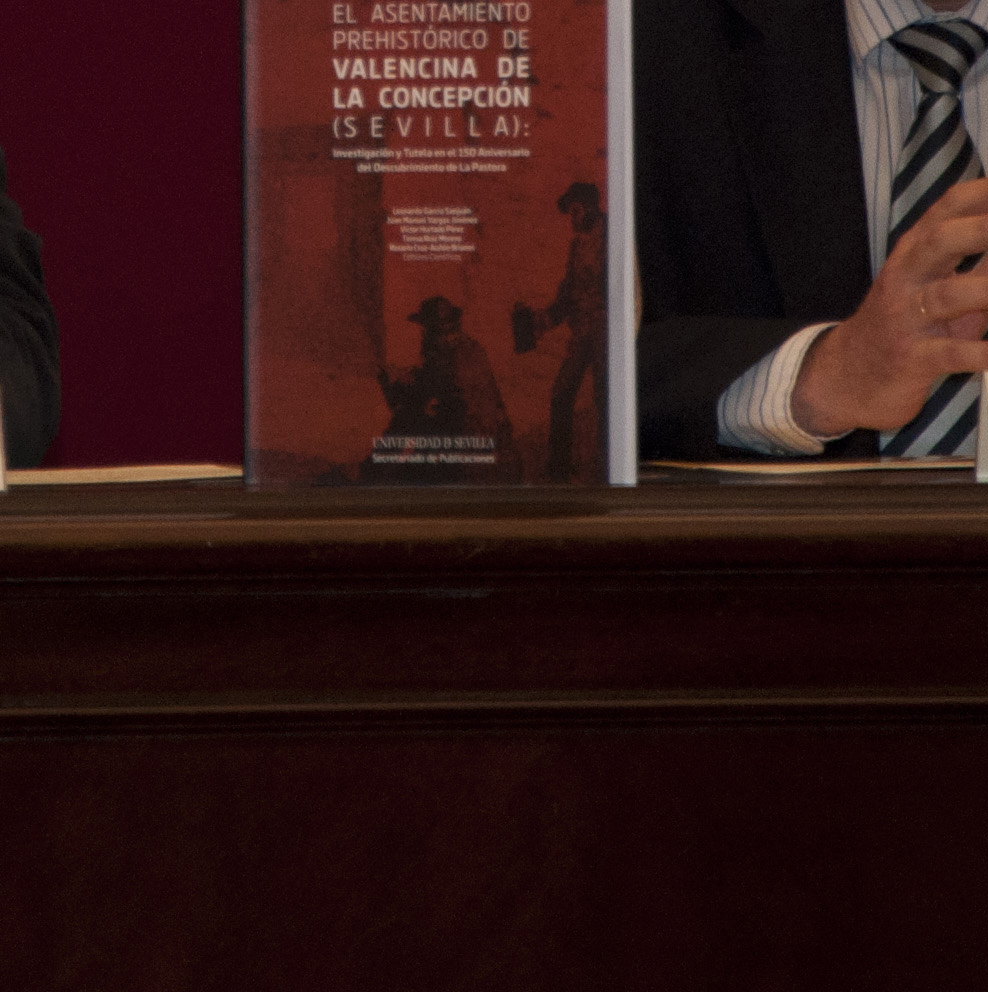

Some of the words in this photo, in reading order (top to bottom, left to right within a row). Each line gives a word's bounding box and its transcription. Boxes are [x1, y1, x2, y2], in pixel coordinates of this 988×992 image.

[333, 3, 357, 24] EL
[371, 2, 531, 23] ASENTAMIENTO
[333, 24, 489, 50] PREHISTÓRICO
[503, 29, 530, 49] DE
[333, 58, 478, 80] VALENCINA
[498, 57, 531, 79] DE
[333, 88, 365, 109] LA
[379, 81, 531, 109] CONCEPCIÓN
[333, 148, 395, 159] Investigación
[396, 150, 402, 160] y
[404, 148, 433, 158] Tutela
[434, 150, 446, 158] en
[447, 148, 456, 158] el
[458, 148, 477, 158] 150
[478, 148, 531, 158] Aniversario
[357, 163, 372, 172] del
[374, 163, 445, 172] Descubrimiento
[446, 163, 458, 172] de
[459, 163, 471, 172] La
[472, 162, 508, 172] Pastora
[372, 436, 442, 449] UNIVERSIDAD
[454, 436, 496, 449] SEVILLA
